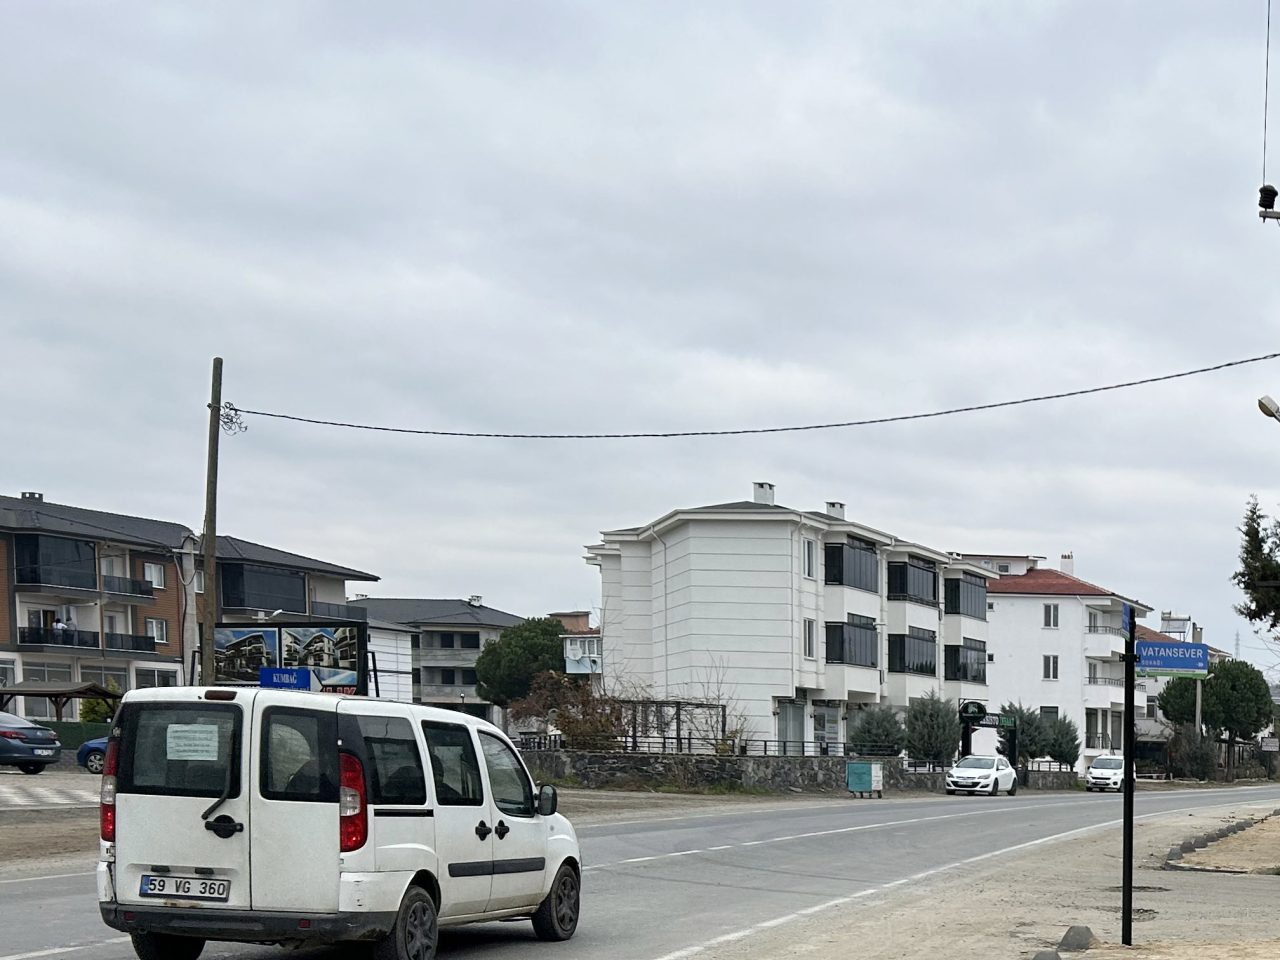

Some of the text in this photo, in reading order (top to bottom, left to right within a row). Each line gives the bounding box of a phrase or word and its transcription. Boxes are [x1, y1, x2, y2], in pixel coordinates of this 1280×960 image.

[1141, 646, 1203, 658] VATANSEVER
[273, 672, 297, 684] KUMBAĞ
[148, 879, 226, 896] 59 VG 360
